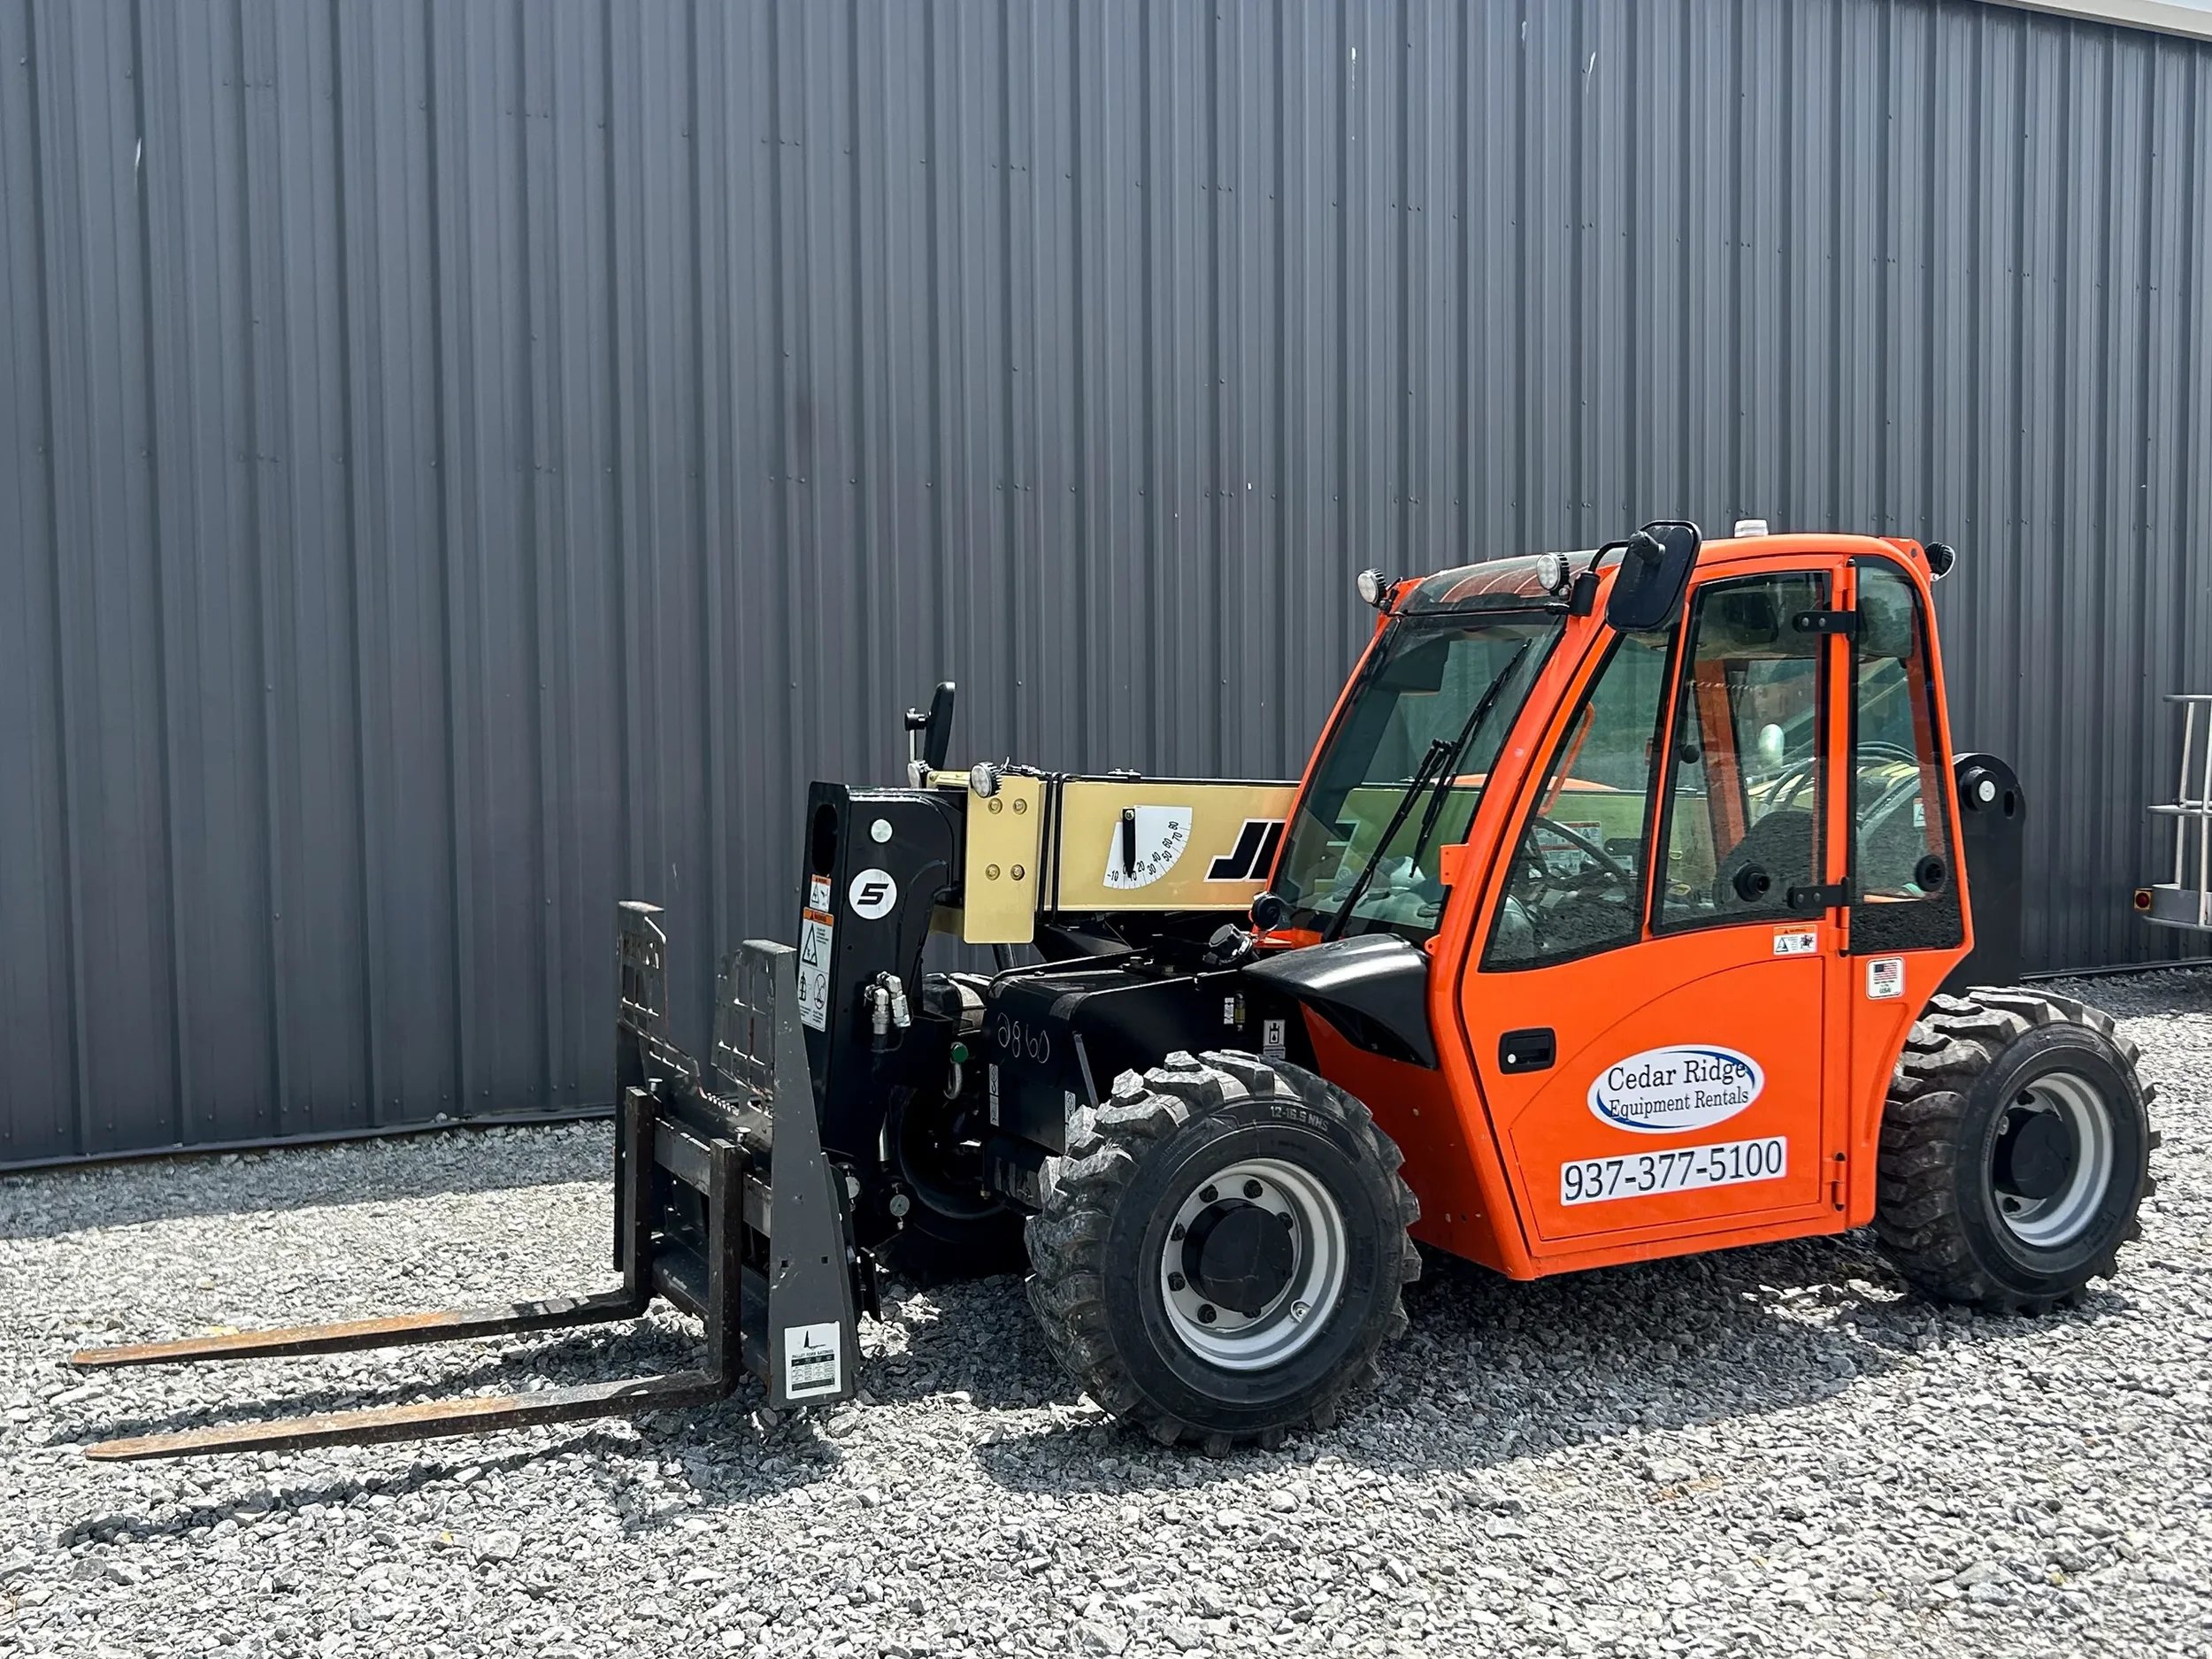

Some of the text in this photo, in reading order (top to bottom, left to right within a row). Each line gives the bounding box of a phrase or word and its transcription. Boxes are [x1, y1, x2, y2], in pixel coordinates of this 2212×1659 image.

[1168, 821, 1179, 830] 80
[1171, 832, 1183, 841] 70
[1162, 838, 1172, 849] 60
[1152, 851, 1161, 863] 40
[1162, 850, 1172, 862] 50
[1137, 860, 1145, 872] 20
[1147, 864, 1156, 875] 30
[1107, 870, 1119, 881] -10
[1608, 1057, 1747, 1092] Cedar Ridge
[1609, 1086, 1748, 1121] Equipment Rentals
[1270, 1105, 1329, 1133] 12-16.5 NHS
[1564, 1140, 1783, 1202] 937-377-5100
